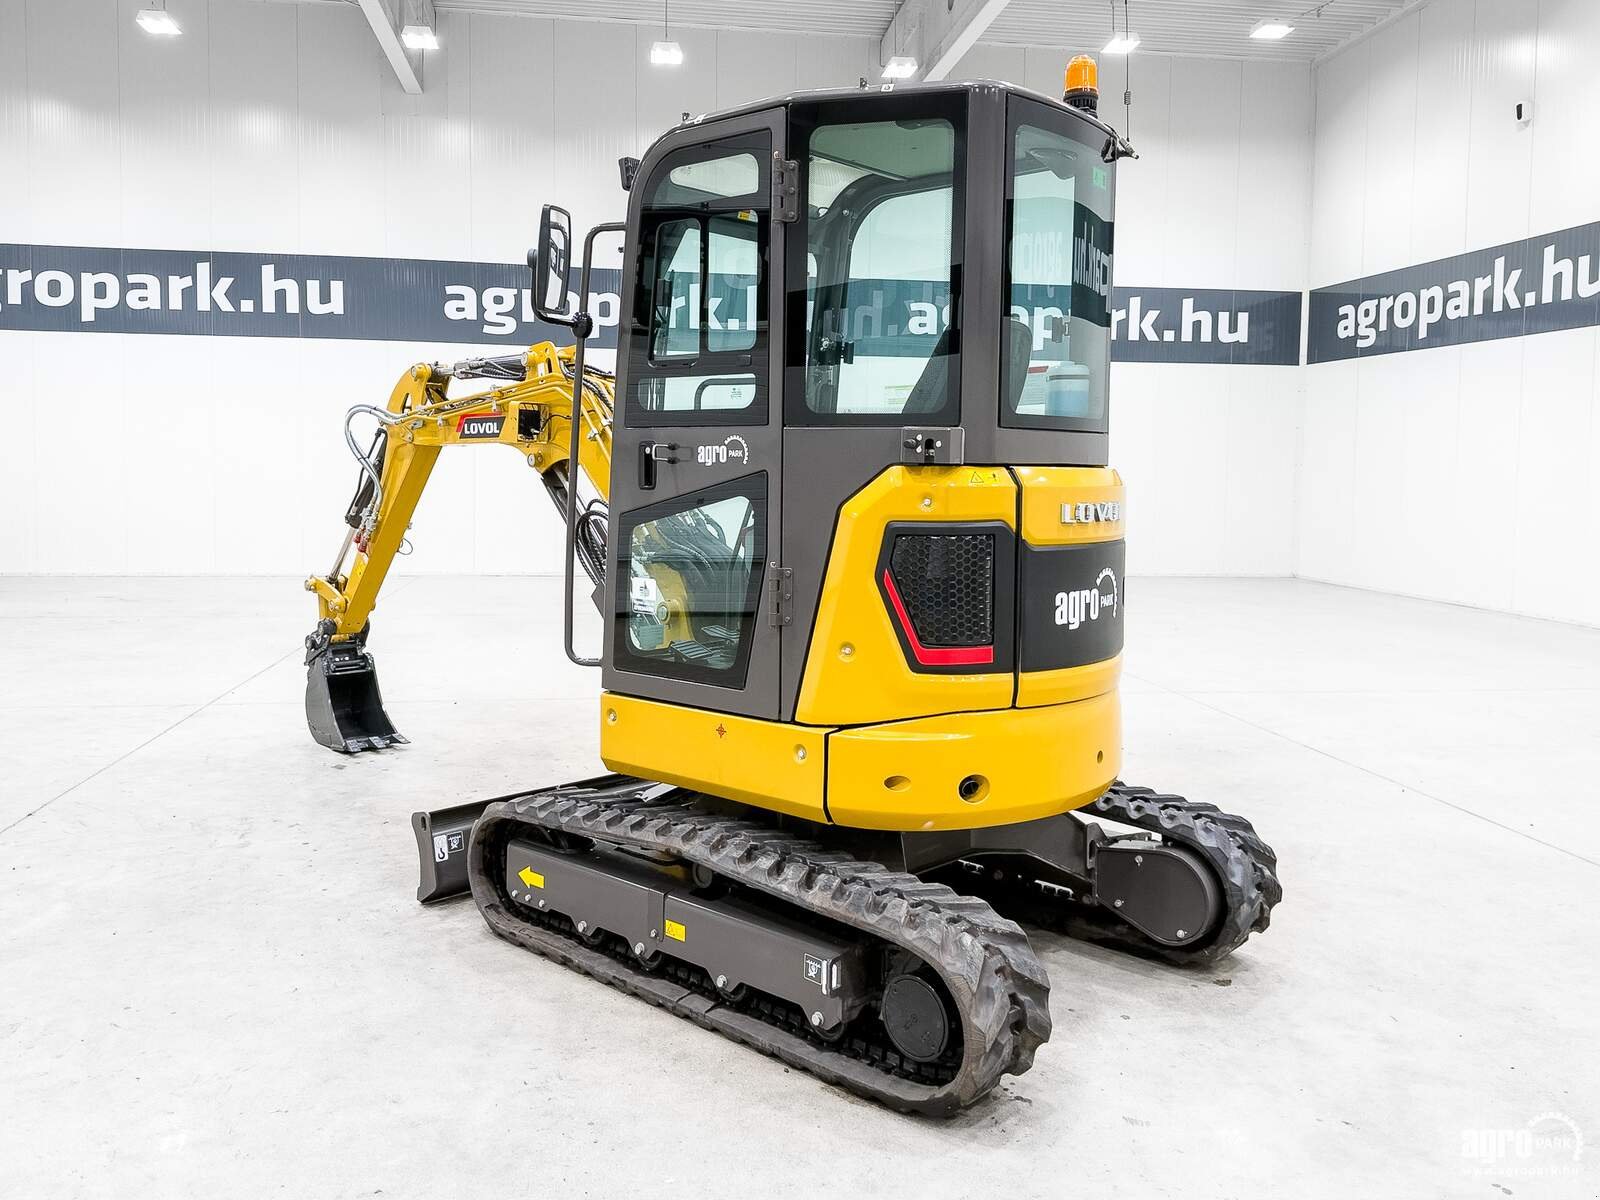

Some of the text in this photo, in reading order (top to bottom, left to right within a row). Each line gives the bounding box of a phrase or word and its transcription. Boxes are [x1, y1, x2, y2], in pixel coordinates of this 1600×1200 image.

[0, 262, 345, 322] ropark.hu
[1337, 244, 1600, 348] agropark.hu
[464, 422, 500, 435] LOVOL
[697, 445, 743, 466] agro PARK
[1061, 502, 1120, 524] LOVO
[1055, 588, 1114, 630] agro PARK
